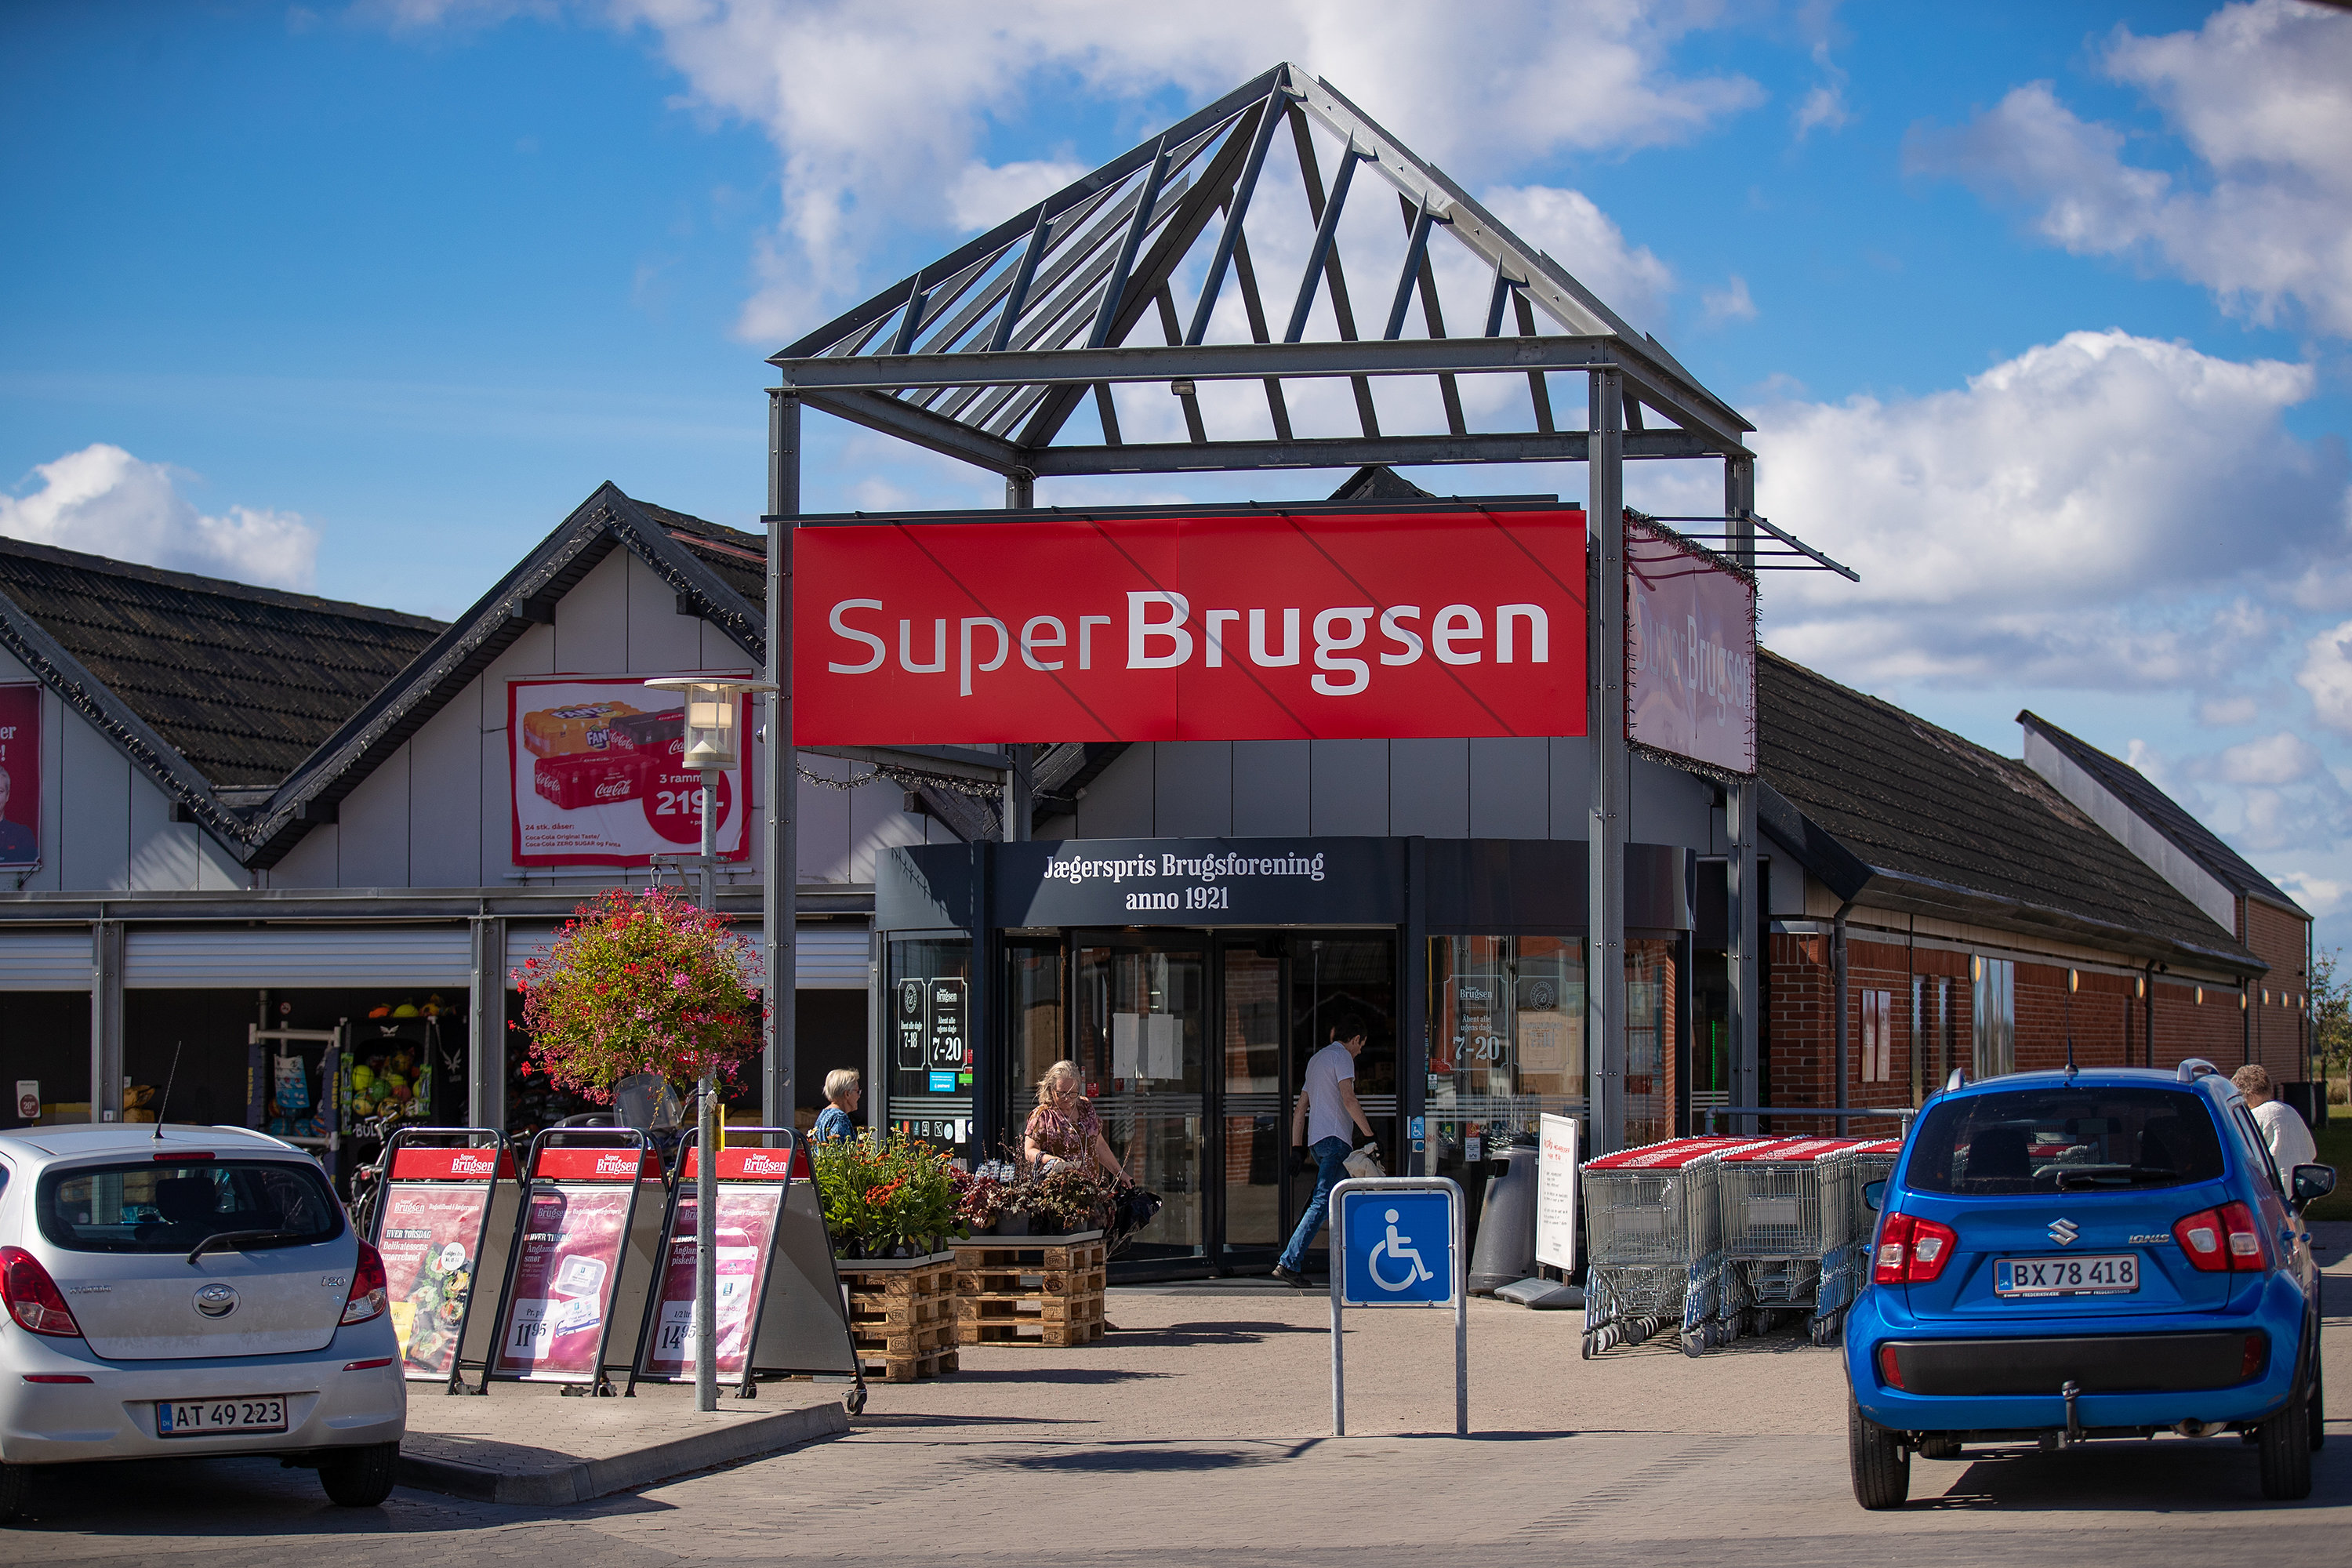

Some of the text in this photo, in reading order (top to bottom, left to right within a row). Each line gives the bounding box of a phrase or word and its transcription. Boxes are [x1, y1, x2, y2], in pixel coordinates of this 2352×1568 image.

[828, 590, 1549, 697] SuperBrugsen
[1635, 593, 1750, 728] SuperBrugsen
[586, 728, 610, 745] FANT
[659, 774, 702, 783] 3 ramm
[1044, 852, 1325, 884] Jægerspris Brugsforening
[1126, 887, 1229, 910] anno 1921
[937, 991, 957, 1003] Brugsen
[1460, 989, 1493, 1000] Brugsen
[904, 1032, 917, 1047] 7-18
[933, 1036, 961, 1061] 7-20
[1453, 1036, 1499, 1060] 7-20
[452, 1158, 494, 1174] Brugsen
[596, 1159, 639, 1174] Brugsen
[743, 1158, 786, 1174] Brugsen
[394, 1202, 425, 1214] Brugsen
[538, 1207, 565, 1219] Brugse
[386, 1229, 432, 1239] HVER TORSDAG
[2129, 1234, 2170, 1243] IGNIS
[383, 1241, 428, 1250] Delikatessens
[321, 1276, 346, 1286] i20
[2014, 1261, 2133, 1287] BX 78 418
[176, 1402, 281, 1426] AT 49 223
